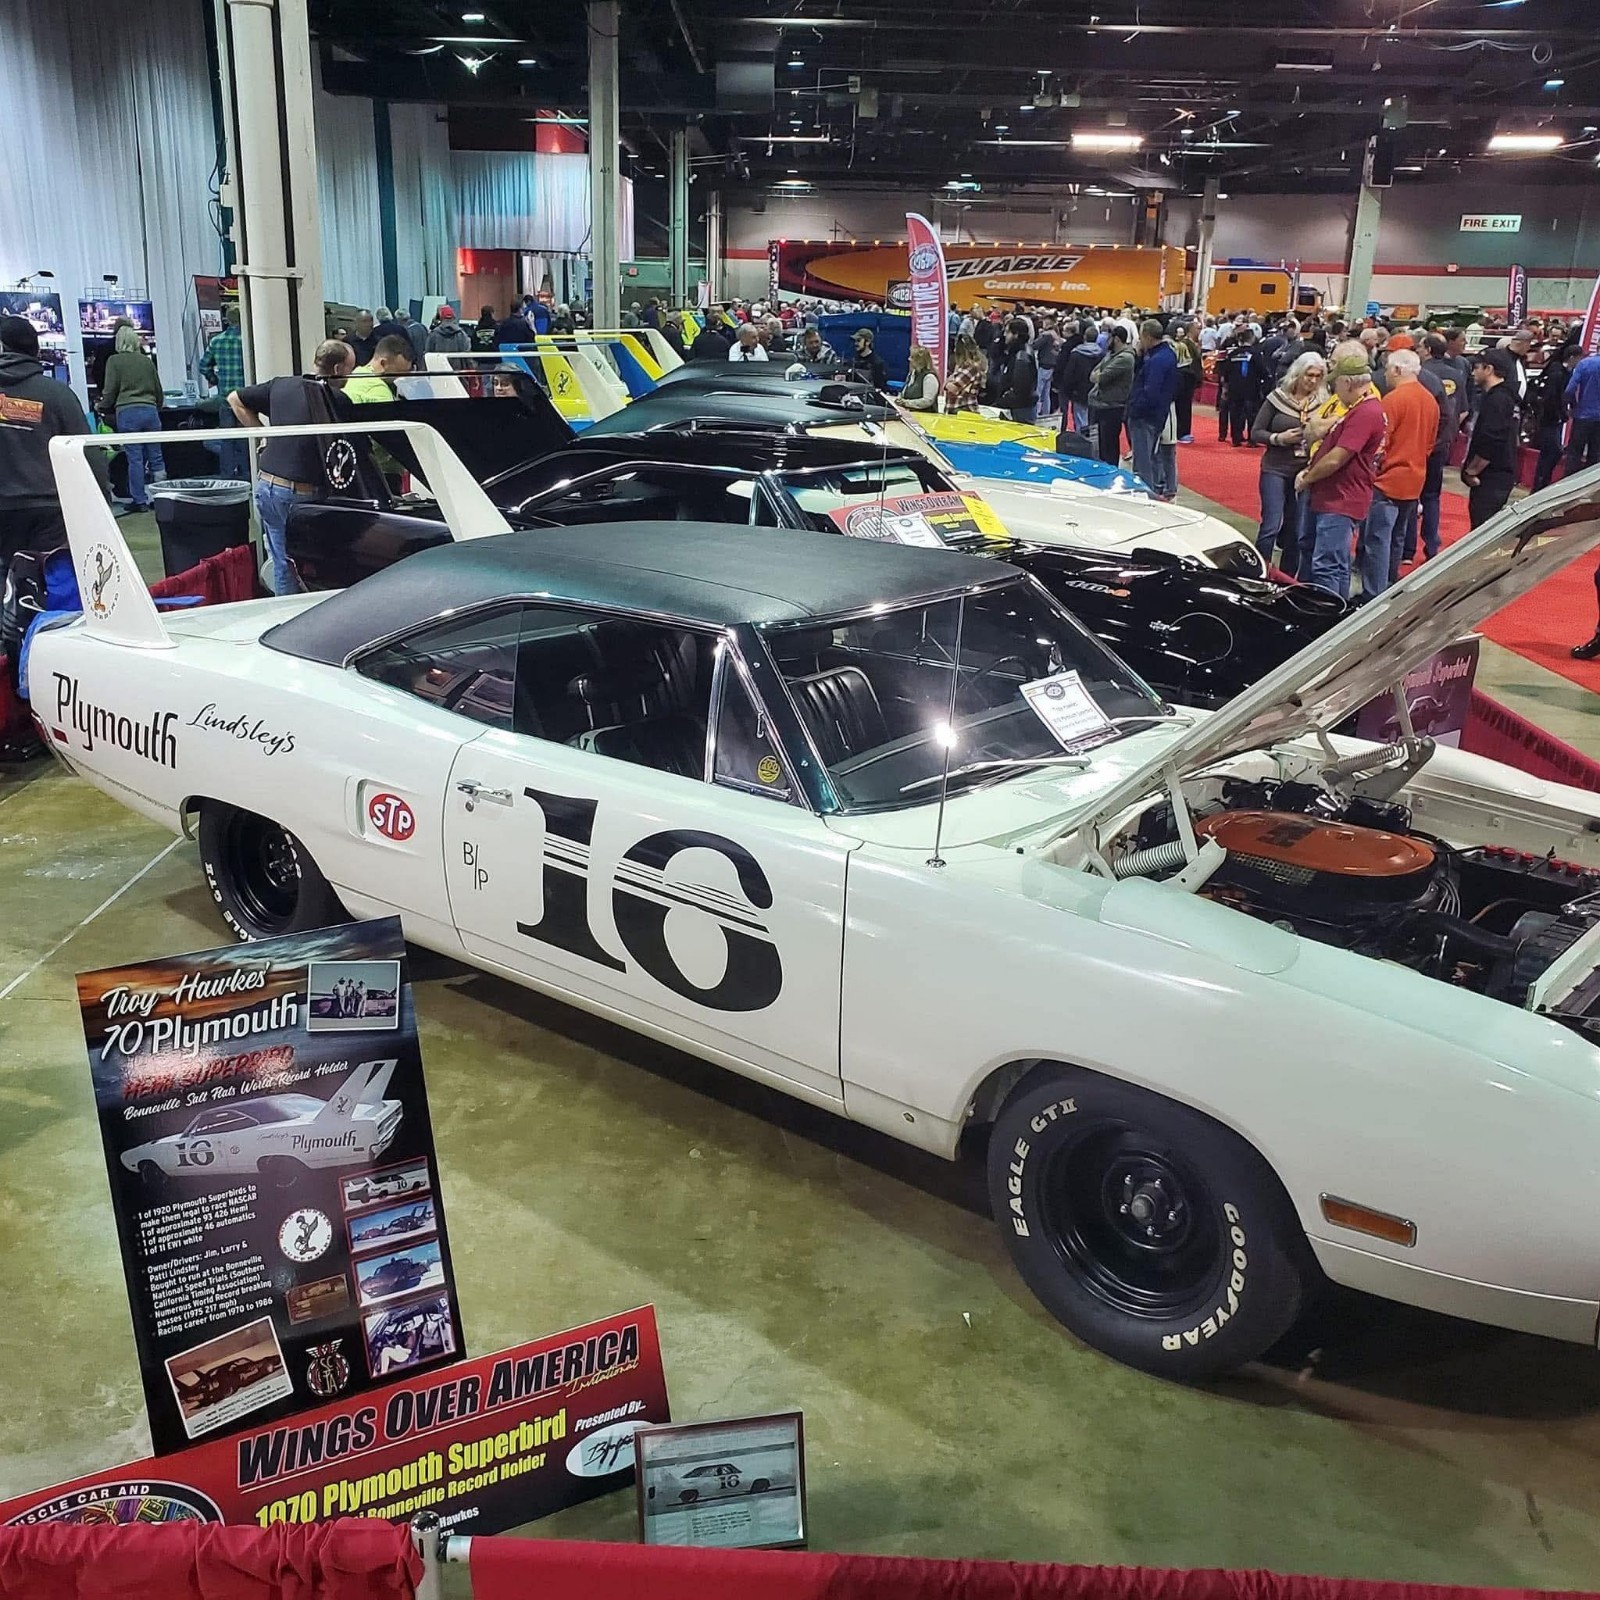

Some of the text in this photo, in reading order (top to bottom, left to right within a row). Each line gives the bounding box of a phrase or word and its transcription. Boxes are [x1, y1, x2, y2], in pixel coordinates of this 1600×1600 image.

[1464, 219, 1517, 228] FIRE EXIT
[946, 256, 1081, 279] ELIABLE
[984, 280, 1091, 292] Carriers, Inc.
[52, 672, 296, 769] Plymouth Lindsley's
[372, 796, 412, 834] STP
[516, 786, 783, 1012] 16
[223, 910, 256, 942] AGLE
[100, 962, 271, 1020] Troy Hawkes'
[101, 992, 298, 1061] 70 Plymouth
[124, 1060, 349, 1120] Bonneville Salt Flats World Record Holder
[174, 1140, 215, 1168] 16
[291, 1130, 356, 1154] Plymouth
[144, 1209, 152, 1219] of
[153, 1206, 171, 1216] 1920
[172, 1197, 207, 1212] Plymouth
[208, 1187, 247, 1202] Superbirds
[248, 1184, 256, 1192] to
[1007, 1137, 1031, 1238] EAGLE
[140, 1193, 258, 1229] make them legal to race NASCAR
[146, 1228, 155, 1237] of
[156, 1217, 202, 1235] approximate
[202, 1213, 213, 1222] 93
[214, 1208, 229, 1220] 426
[230, 1204, 248, 1214] Hemi
[148, 1237, 156, 1246] of
[158, 1226, 203, 1244] approximate
[204, 1220, 214, 1230] 46
[216, 1212, 256, 1228] automatics
[148, 1240, 248, 1274] Owner/Drivers: Jim, Larry &
[150, 1245, 158, 1255] of
[183, 1235, 204, 1246] white
[149, 1264, 200, 1282] Patti Lindsley
[150, 1256, 262, 1292] Bought to run at the Bonneville
[152, 1264, 265, 1301] National Speed Trials (Southern
[1161, 1202, 1248, 1351] GOODYEAR
[154, 1274, 262, 1310] California Timing Association)
[155, 1280, 272, 1318] Numerous World Record breaking
[157, 1298, 238, 1328] passes (1975 217 mph)
[158, 1296, 273, 1336] Racing career from 1970 to 1986
[565, 1360, 639, 1398] Invitational
[238, 1406, 378, 1488] WINGS
[384, 1374, 482, 1440] OVER
[484, 1324, 640, 1410] AMERICA
[574, 1403, 628, 1432] Presented
[256, 1408, 566, 1530] 1970 Plymouth Superbird
[368, 1452, 546, 1520] Bonneville Record Holder
[718, 1474, 740, 1490] 16
[16, 1485, 150, 1526] SCLE CAR AND
[440, 1506, 480, 1528] Hawkes
